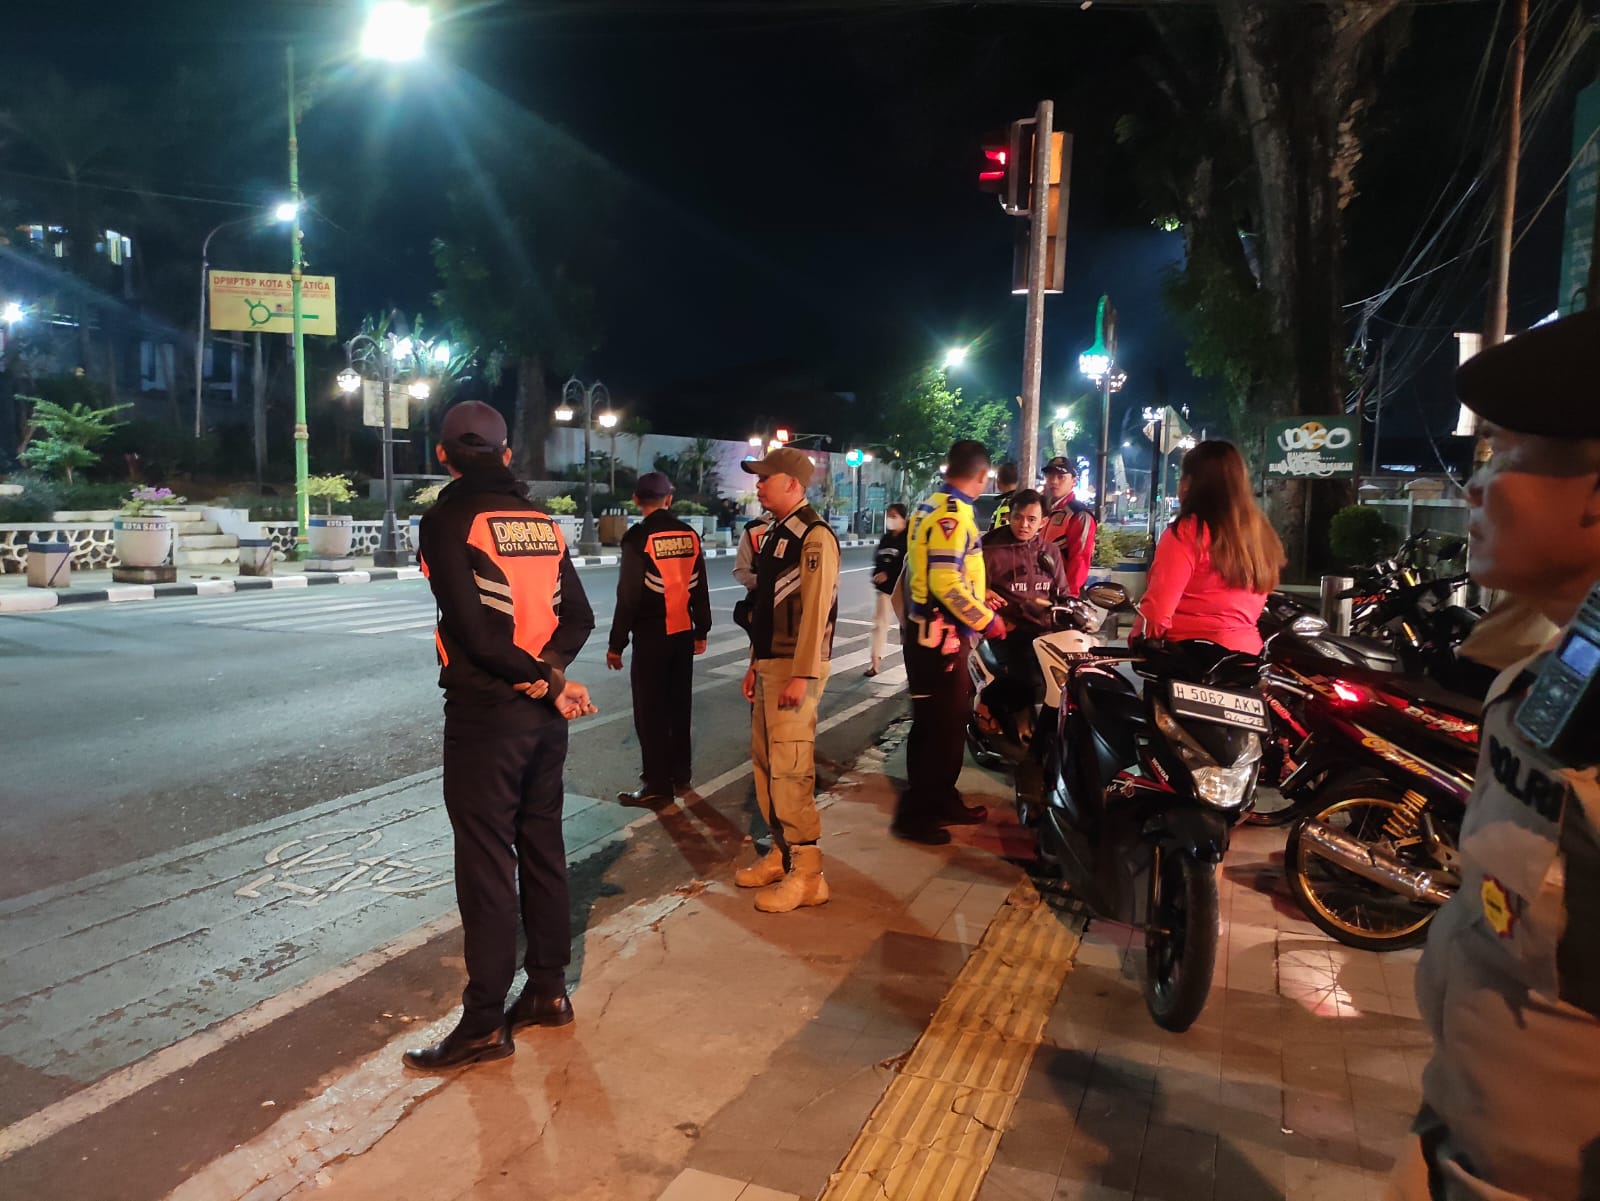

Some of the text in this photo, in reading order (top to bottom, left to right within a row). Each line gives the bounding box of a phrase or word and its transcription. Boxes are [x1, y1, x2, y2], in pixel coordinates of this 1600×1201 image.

[213, 276, 330, 291] DPMPTSP KOTA SATIGA
[493, 521, 556, 543] DISHUB
[500, 542, 559, 552] KOTA SALATIGA
[654, 537, 693, 552] DISHUB
[1175, 686, 1261, 714] H 5062 AKW
[1152, 757, 1169, 782] HONDA
